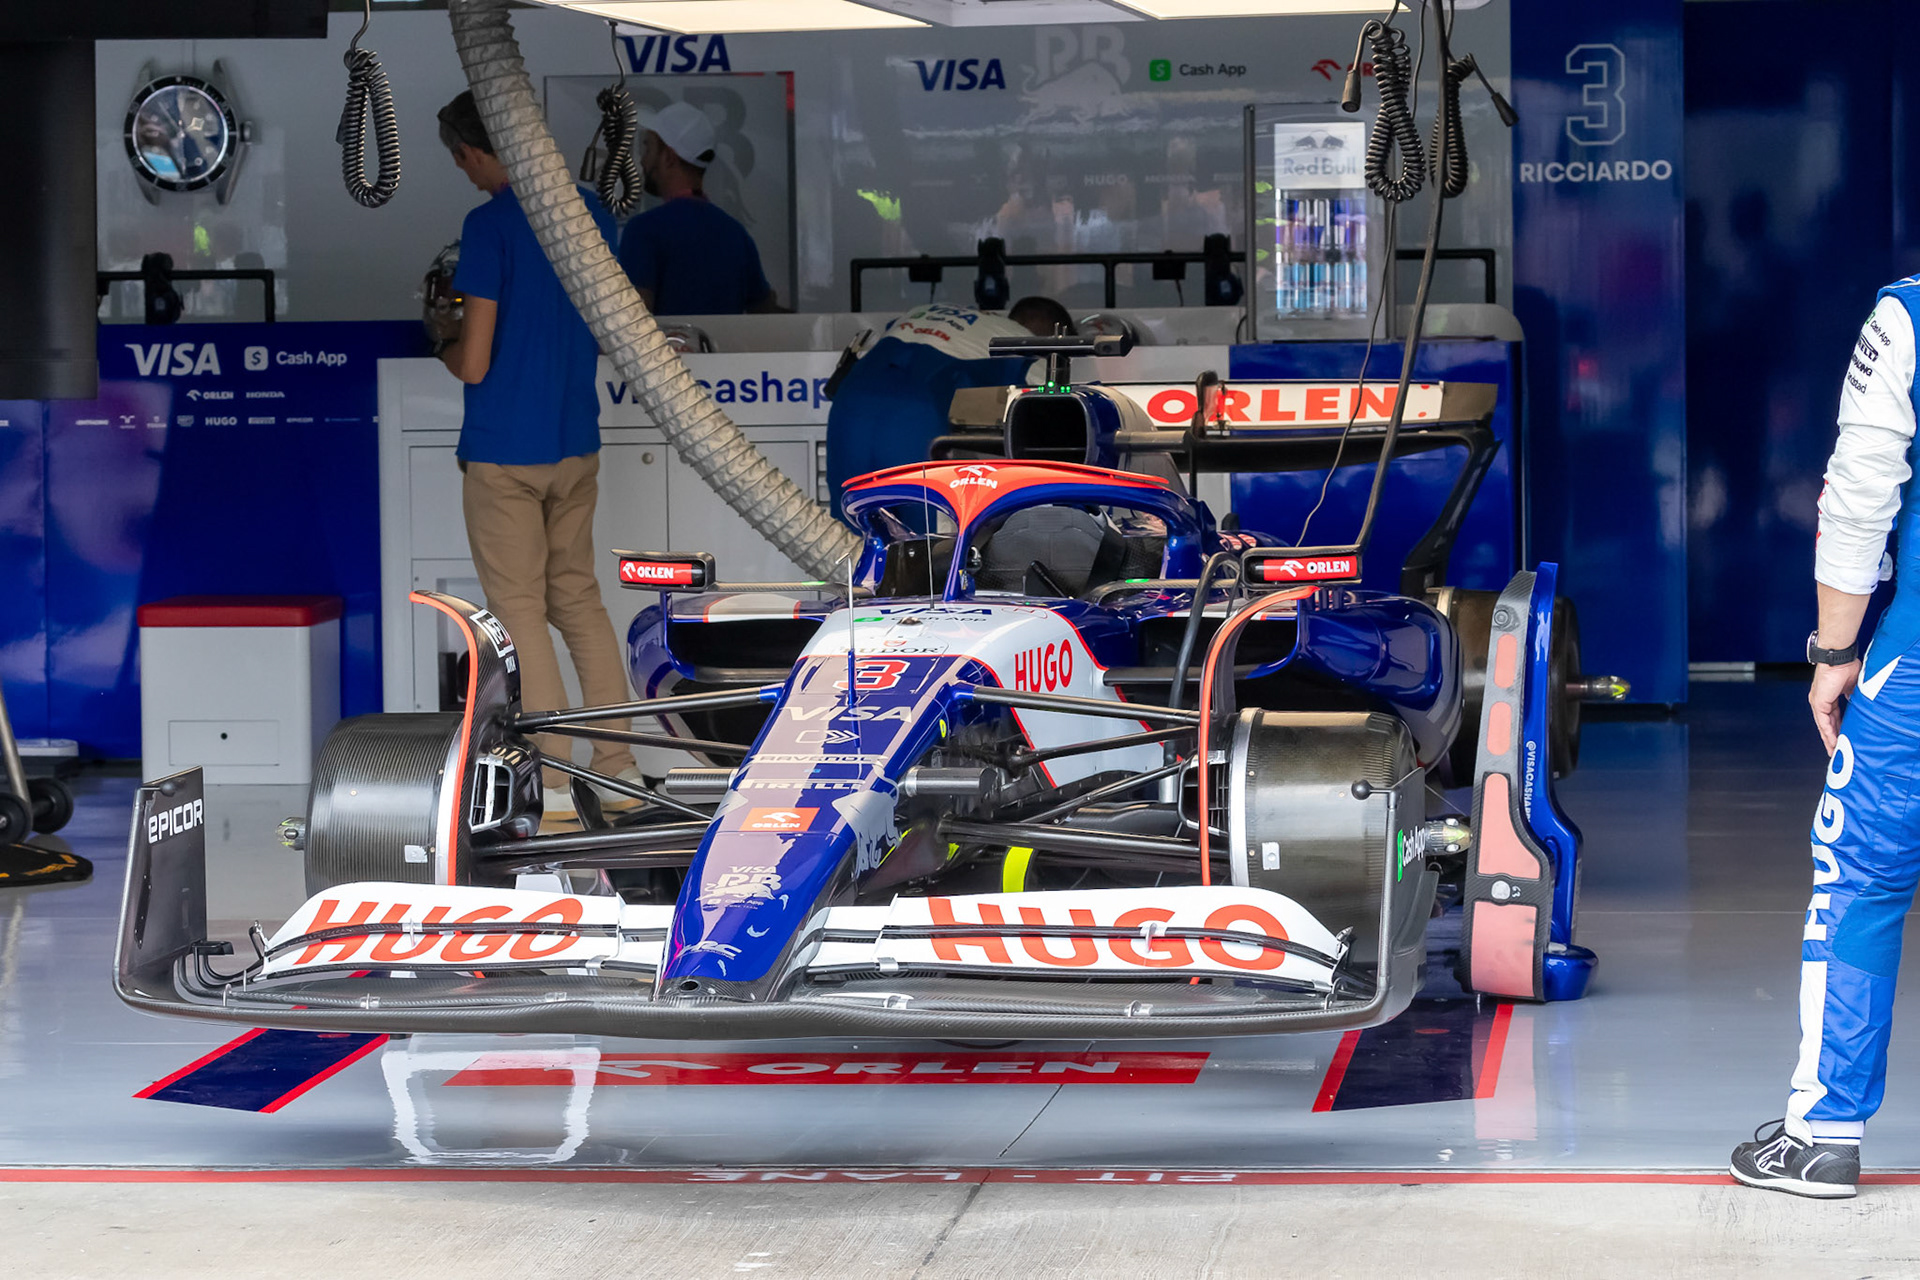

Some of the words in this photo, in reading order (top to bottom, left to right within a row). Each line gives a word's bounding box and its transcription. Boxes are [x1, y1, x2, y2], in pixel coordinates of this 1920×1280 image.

[616, 34, 731, 73] VISA
[909, 58, 1006, 91] VISA
[1179, 63, 1214, 76] Cash
[1217, 63, 1246, 80] App
[1566, 43, 1625, 145] 3
[1520, 159, 1673, 183] RICCIARDO
[1083, 174, 1128, 186] HUGO
[1870, 320, 1882, 336] Cash
[1879, 331, 1891, 347] App
[124, 342, 221, 377] VISA
[276, 351, 312, 365] Cash
[316, 351, 348, 368] App
[205, 417, 237, 426] HUGO
[949, 477, 998, 489] ORLEN
[636, 566, 674, 579] ORLEN
[1306, 560, 1350, 574] ORLEN
[1013, 638, 1073, 693] HUGO
[832, 659, 910, 691] 3
[779, 706, 912, 723] VISA
[1803, 733, 1855, 942] HUGO
[729, 865, 777, 874] VISA
[294, 898, 584, 966] HUGO
[927, 896, 1290, 971] HUGO
[746, 1061, 1121, 1075] ORLEN
[685, 1171, 963, 1183] LANE
[1075, 1171, 1238, 1183] PIT
